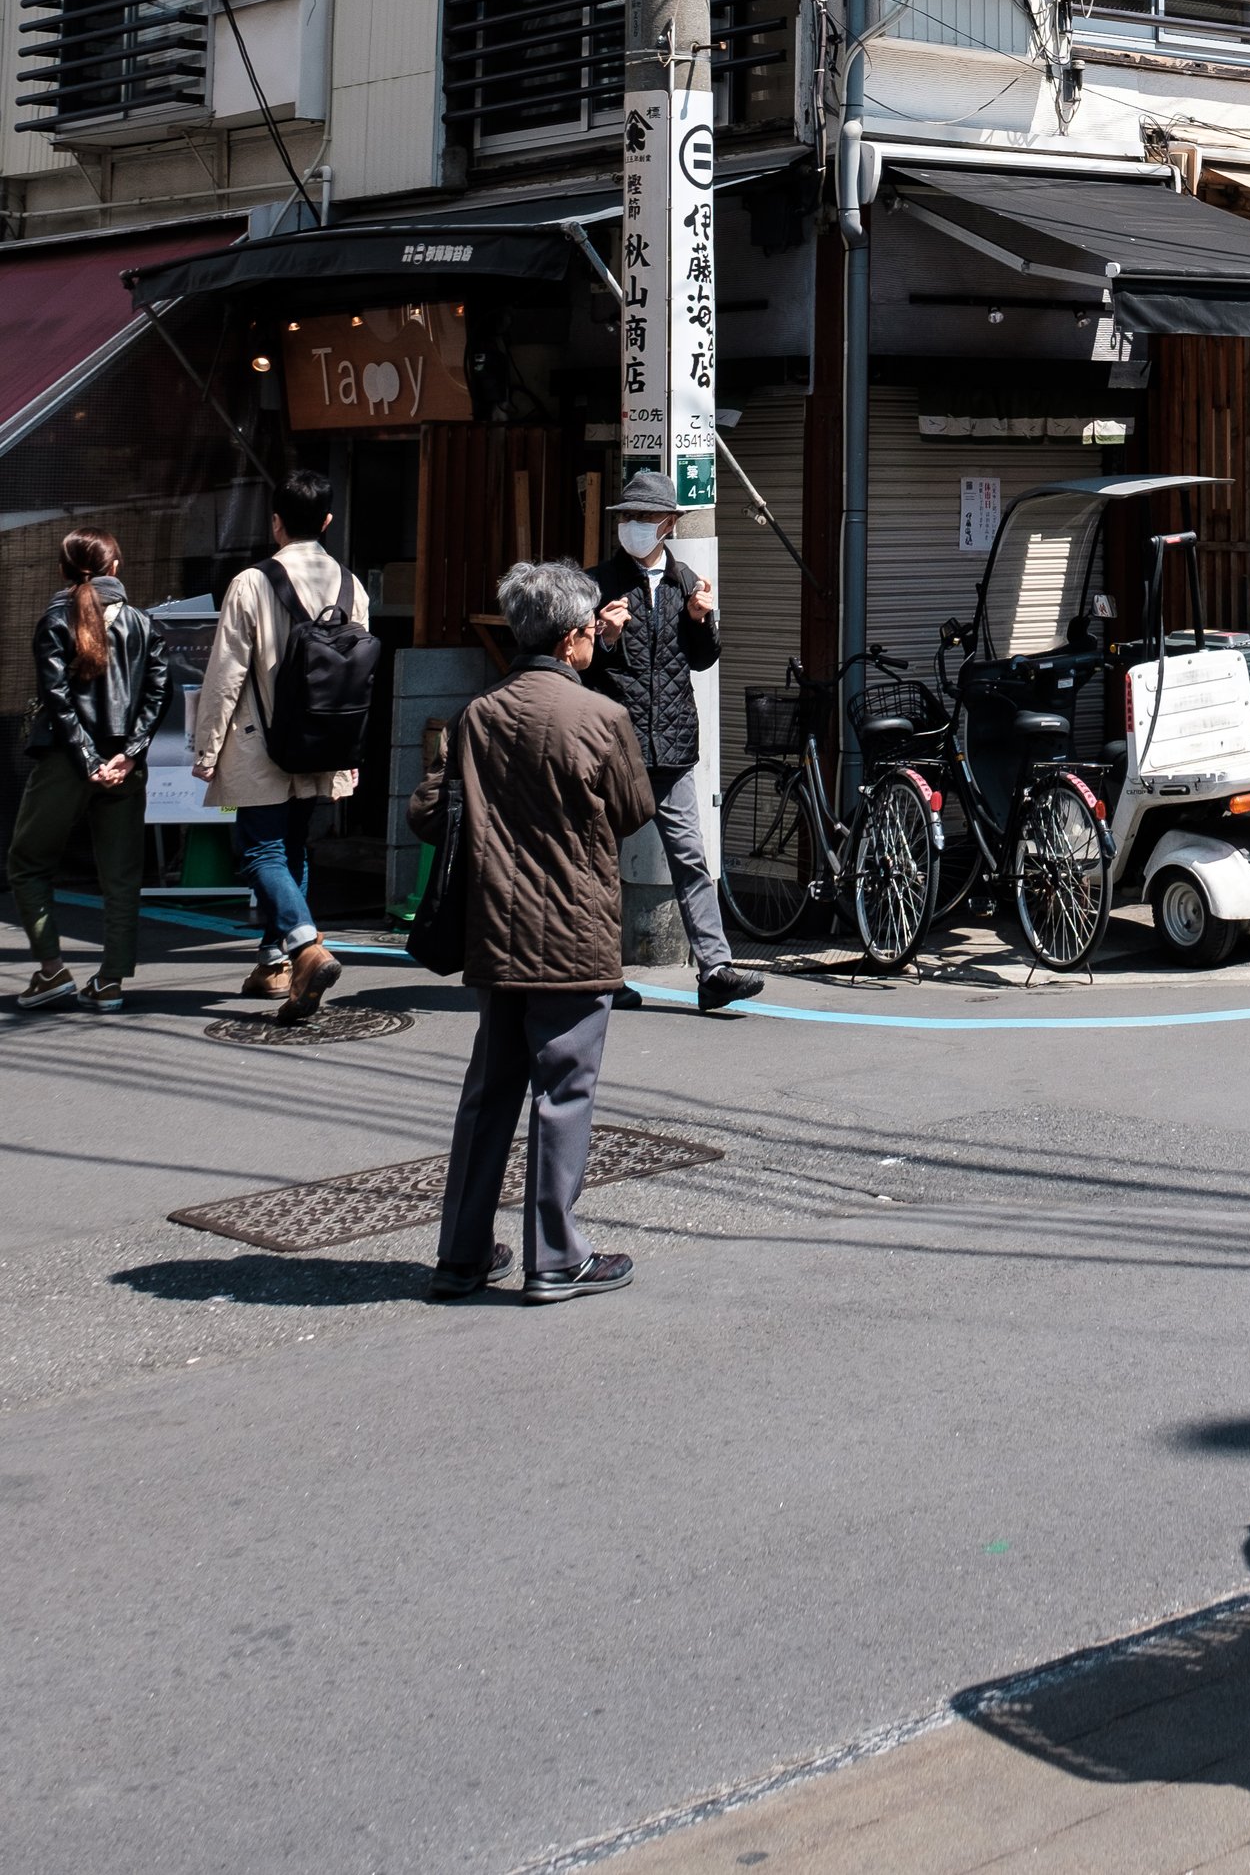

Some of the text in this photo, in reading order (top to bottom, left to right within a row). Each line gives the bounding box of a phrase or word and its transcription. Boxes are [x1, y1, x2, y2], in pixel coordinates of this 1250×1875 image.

[624, 233, 652, 395] 秋山商店
[628, 407, 664, 423] この先
